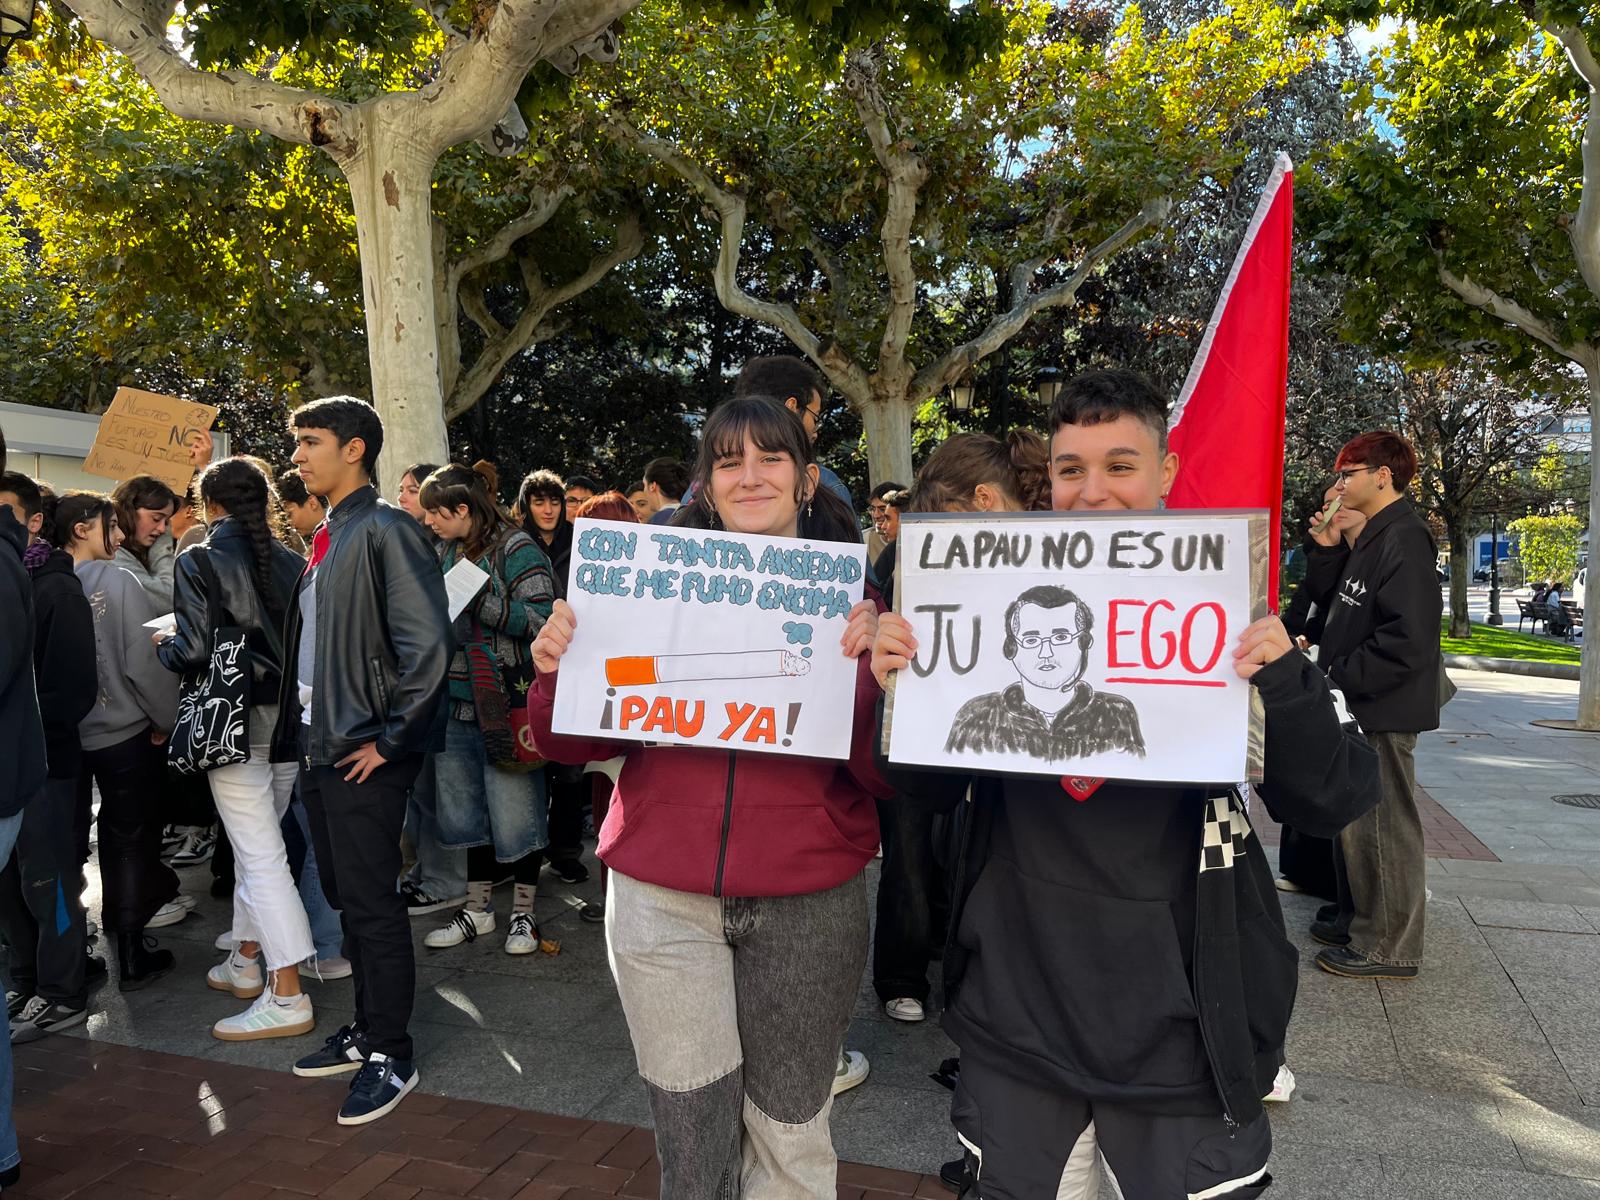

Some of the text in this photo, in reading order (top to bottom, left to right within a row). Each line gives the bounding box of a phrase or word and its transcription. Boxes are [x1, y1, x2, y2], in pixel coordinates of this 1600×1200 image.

[577, 527, 862, 584] CON TANTA ANSIEDAD
[919, 530, 1225, 571] LA PAU NO ES UN
[576, 563, 852, 619] QUE ME FUMO ENCIMA
[911, 599, 1227, 678] JU EGO
[600, 687, 802, 747] ¡PAU YA!
